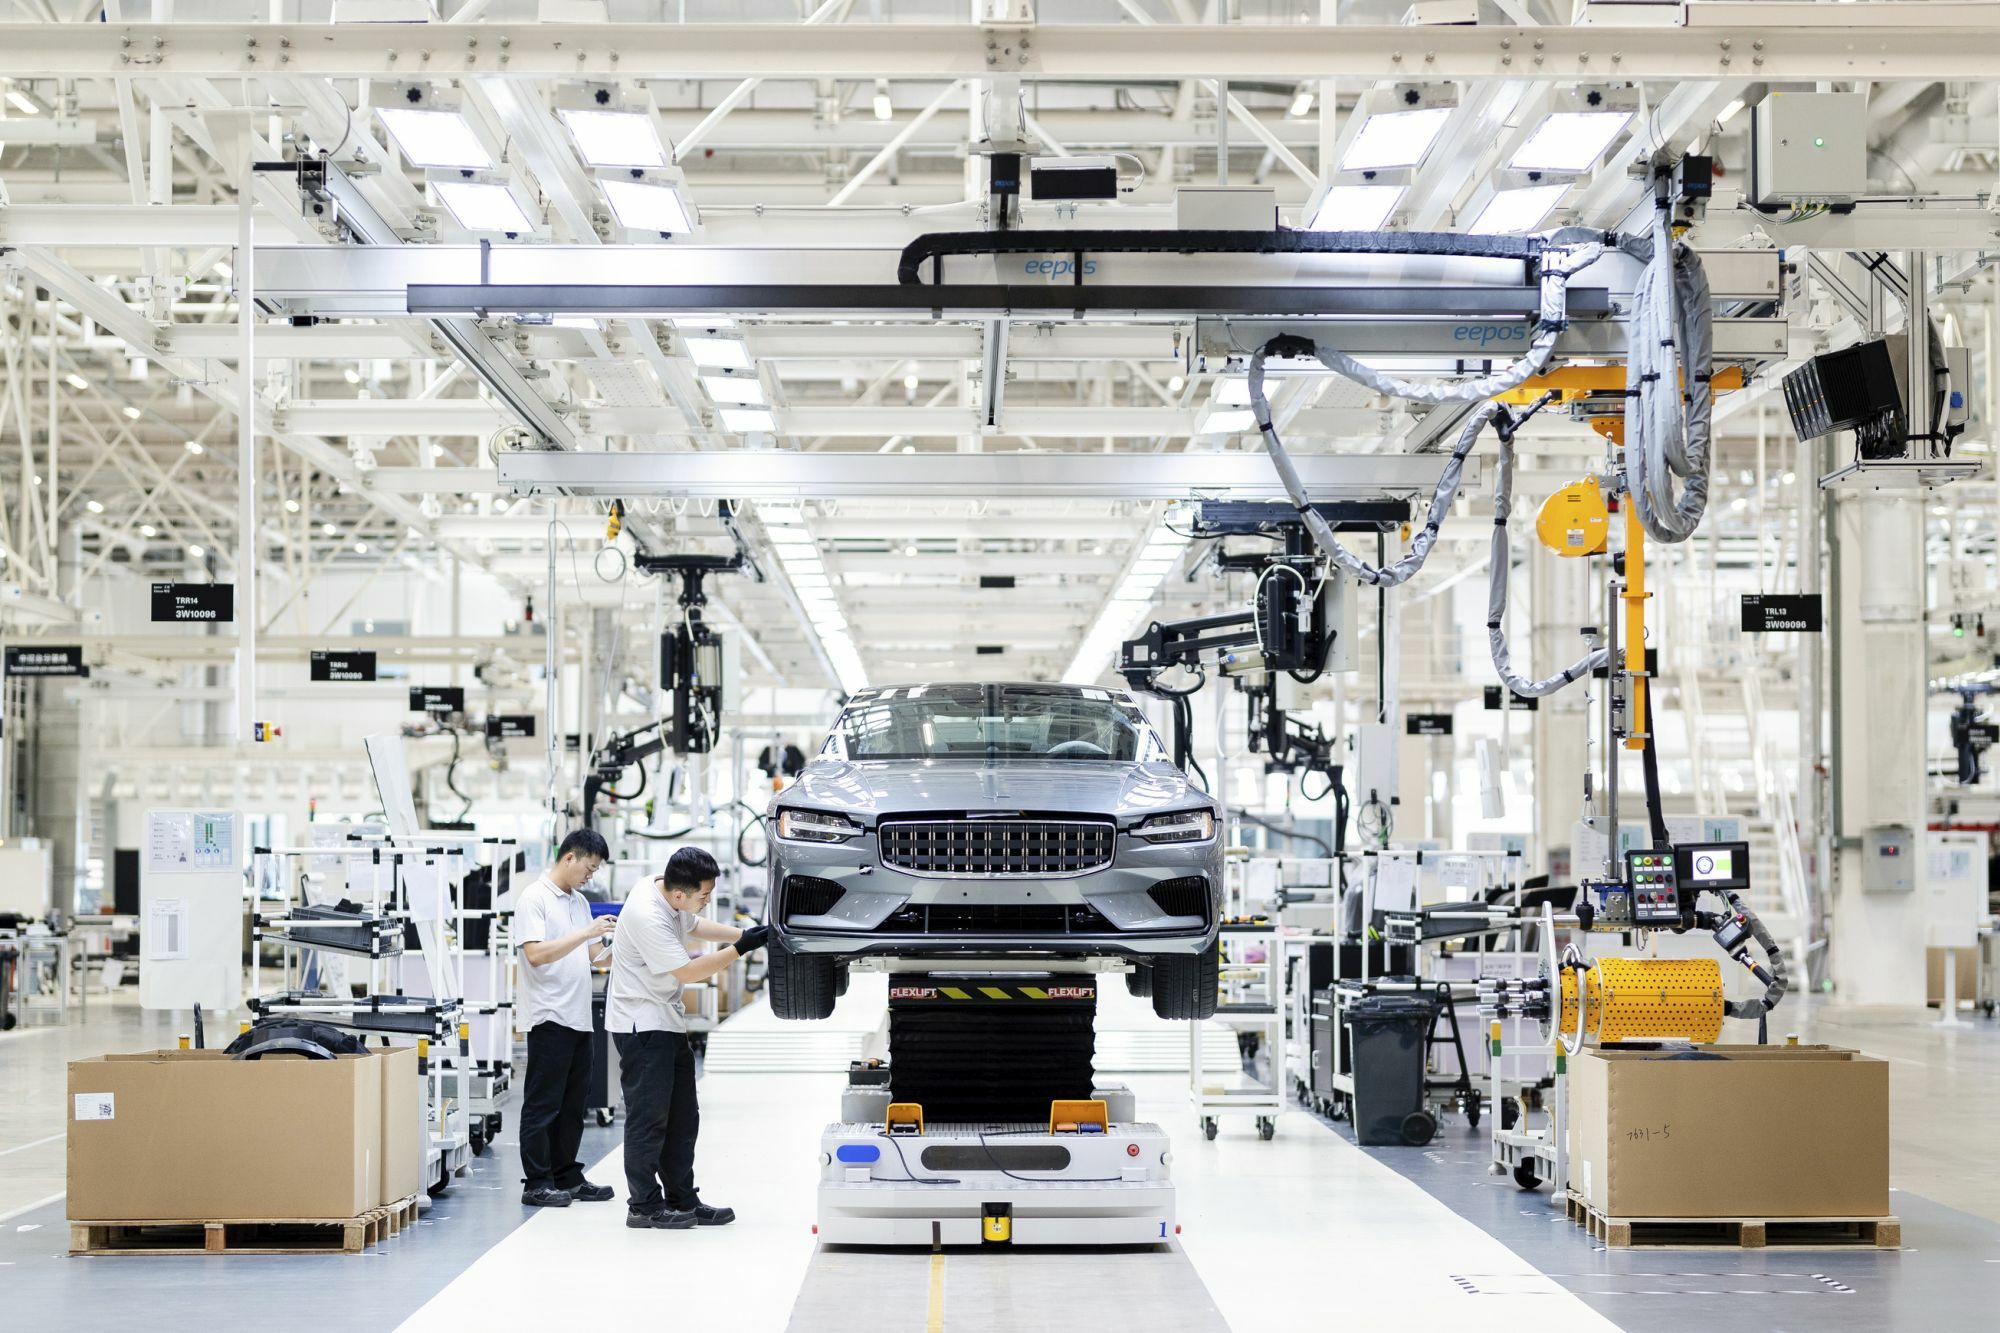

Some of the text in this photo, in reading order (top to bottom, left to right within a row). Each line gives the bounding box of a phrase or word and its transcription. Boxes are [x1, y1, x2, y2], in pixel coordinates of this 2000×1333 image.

[1454, 326, 1526, 347] eepos
[175, 596, 199, 605] TRR14
[175, 610, 217, 619] 3W10096
[1764, 607, 1787, 616] TRL13
[1765, 620, 1807, 629] 3W09096
[890, 987, 937, 998] FLEXLIFT
[1048, 987, 1094, 998] FLEXLIFT
[1158, 1220, 1168, 1238] 1
